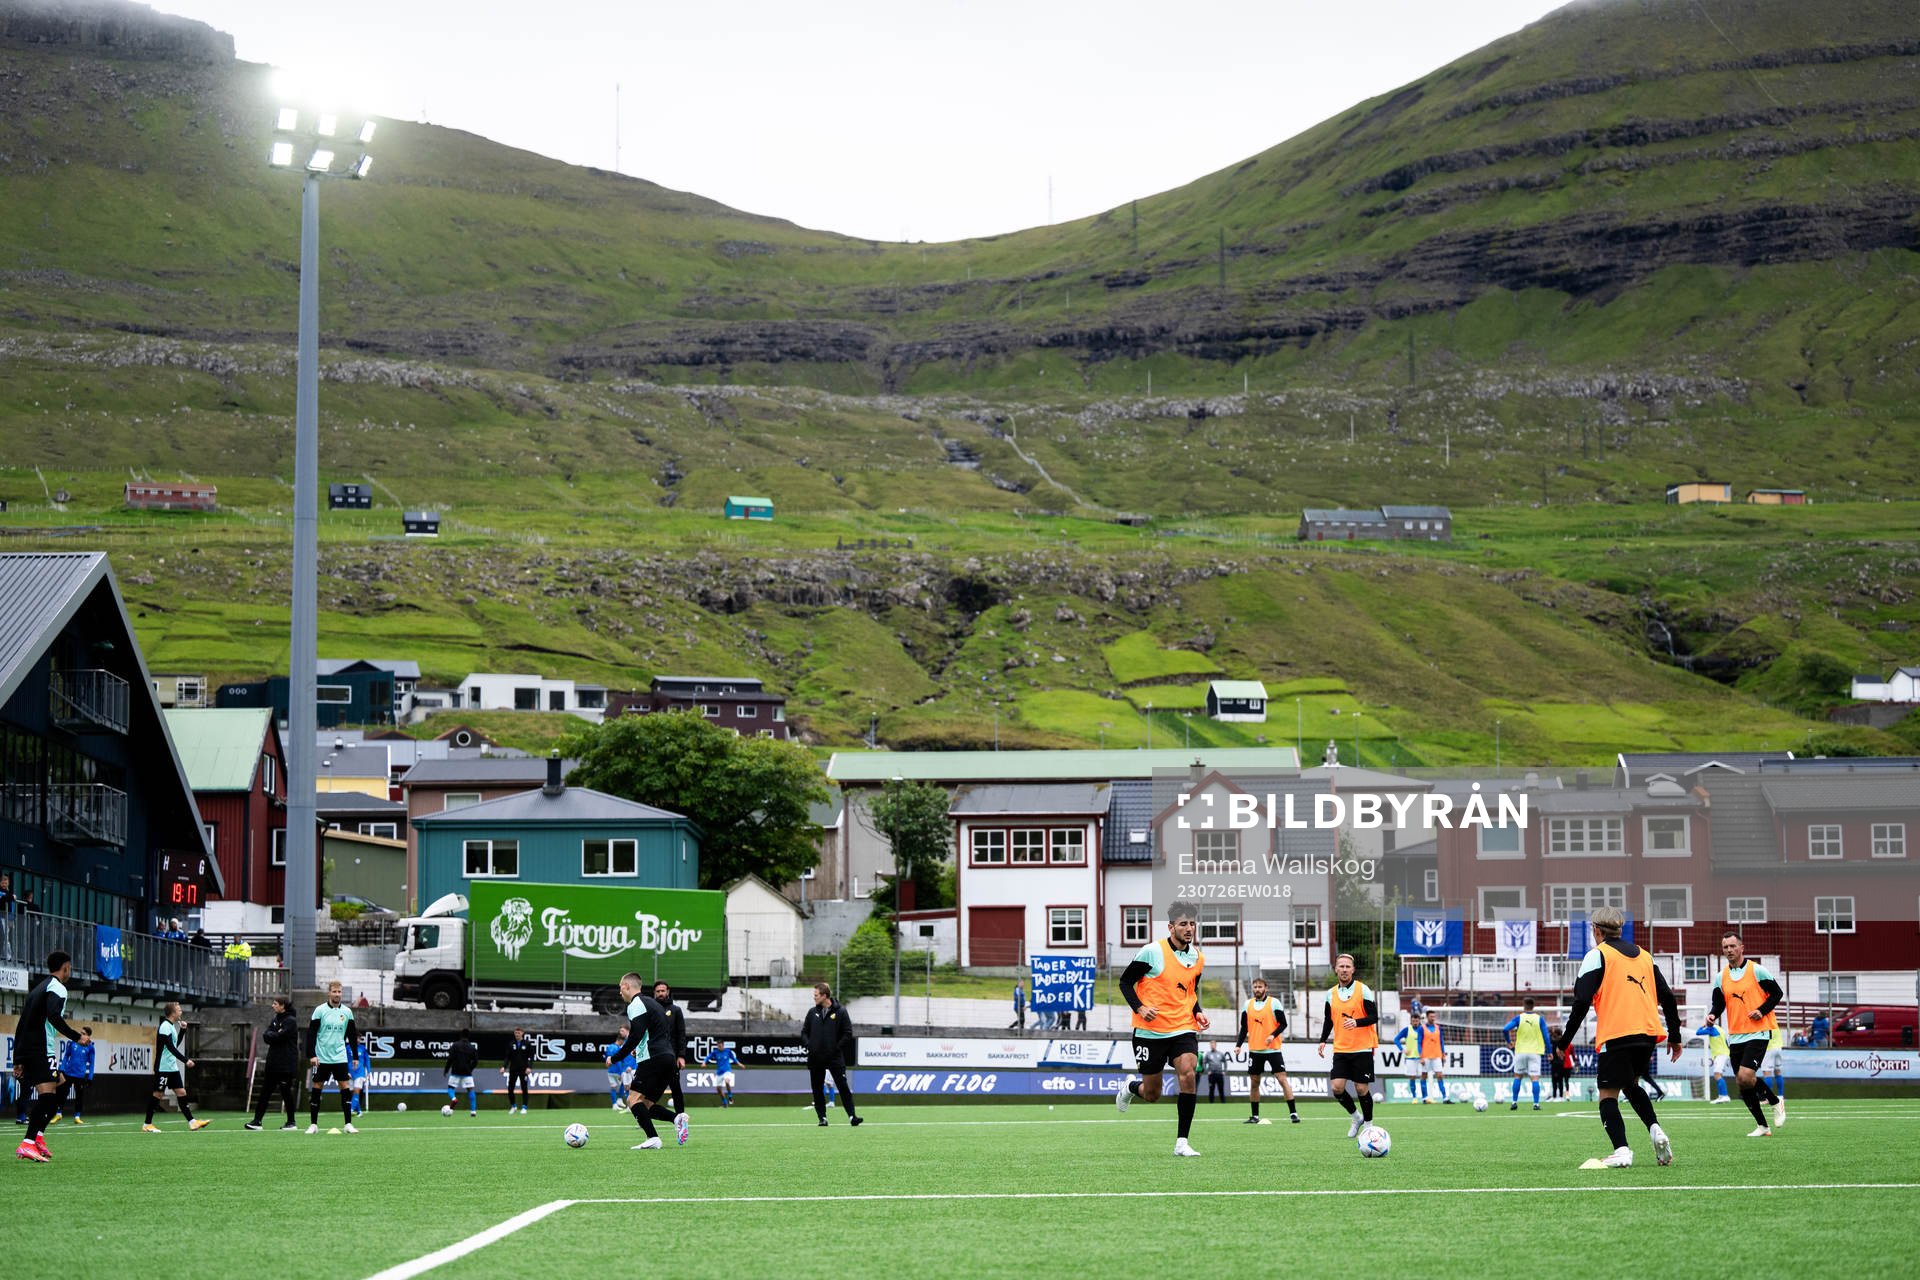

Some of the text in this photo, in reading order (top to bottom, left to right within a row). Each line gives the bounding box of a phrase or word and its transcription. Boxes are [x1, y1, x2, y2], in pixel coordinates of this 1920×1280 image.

[173, 883, 197, 904] 19:17
[541, 907, 702, 959] Föroya Bjór
[415, 1040, 425, 1050] &
[755, 1045, 767, 1054] &
[1060, 1043, 1082, 1055] KBI
[128, 1048, 150, 1071] ASFALT
[865, 1051, 907, 1059] BAKKAFROST
[926, 1052, 968, 1060] BAKKAFROST
[1136, 1046, 1149, 1061] 29
[1836, 1060, 1865, 1069] LOOK
[1871, 1060, 1909, 1071] NORTH
[876, 1073, 998, 1092] FONN FLOG
[1042, 1077, 1076, 1090] effo
